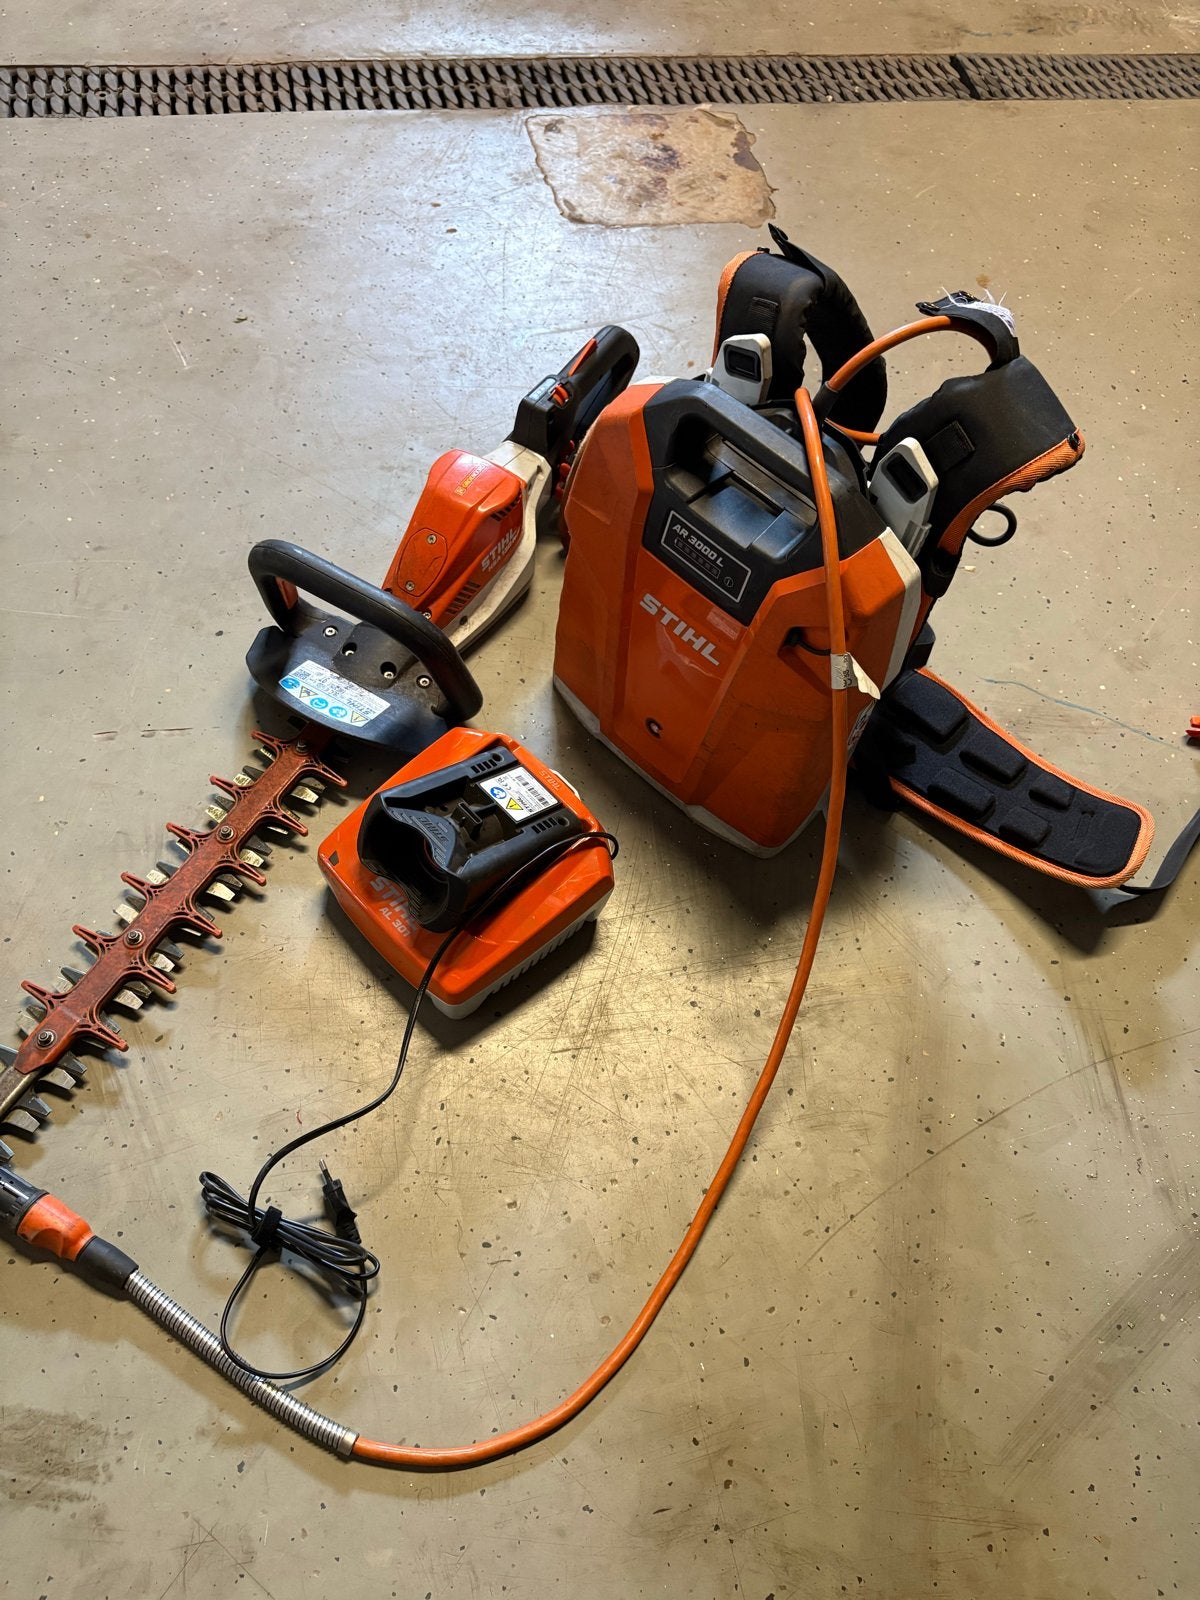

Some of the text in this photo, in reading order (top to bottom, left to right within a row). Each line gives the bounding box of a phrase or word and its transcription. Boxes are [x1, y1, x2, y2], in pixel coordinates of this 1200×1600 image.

[481, 528, 517, 572] STIHL
[672, 524, 724, 568] AR 3000 L
[639, 593, 720, 666] STIHL
[379, 906, 393, 920] AL
